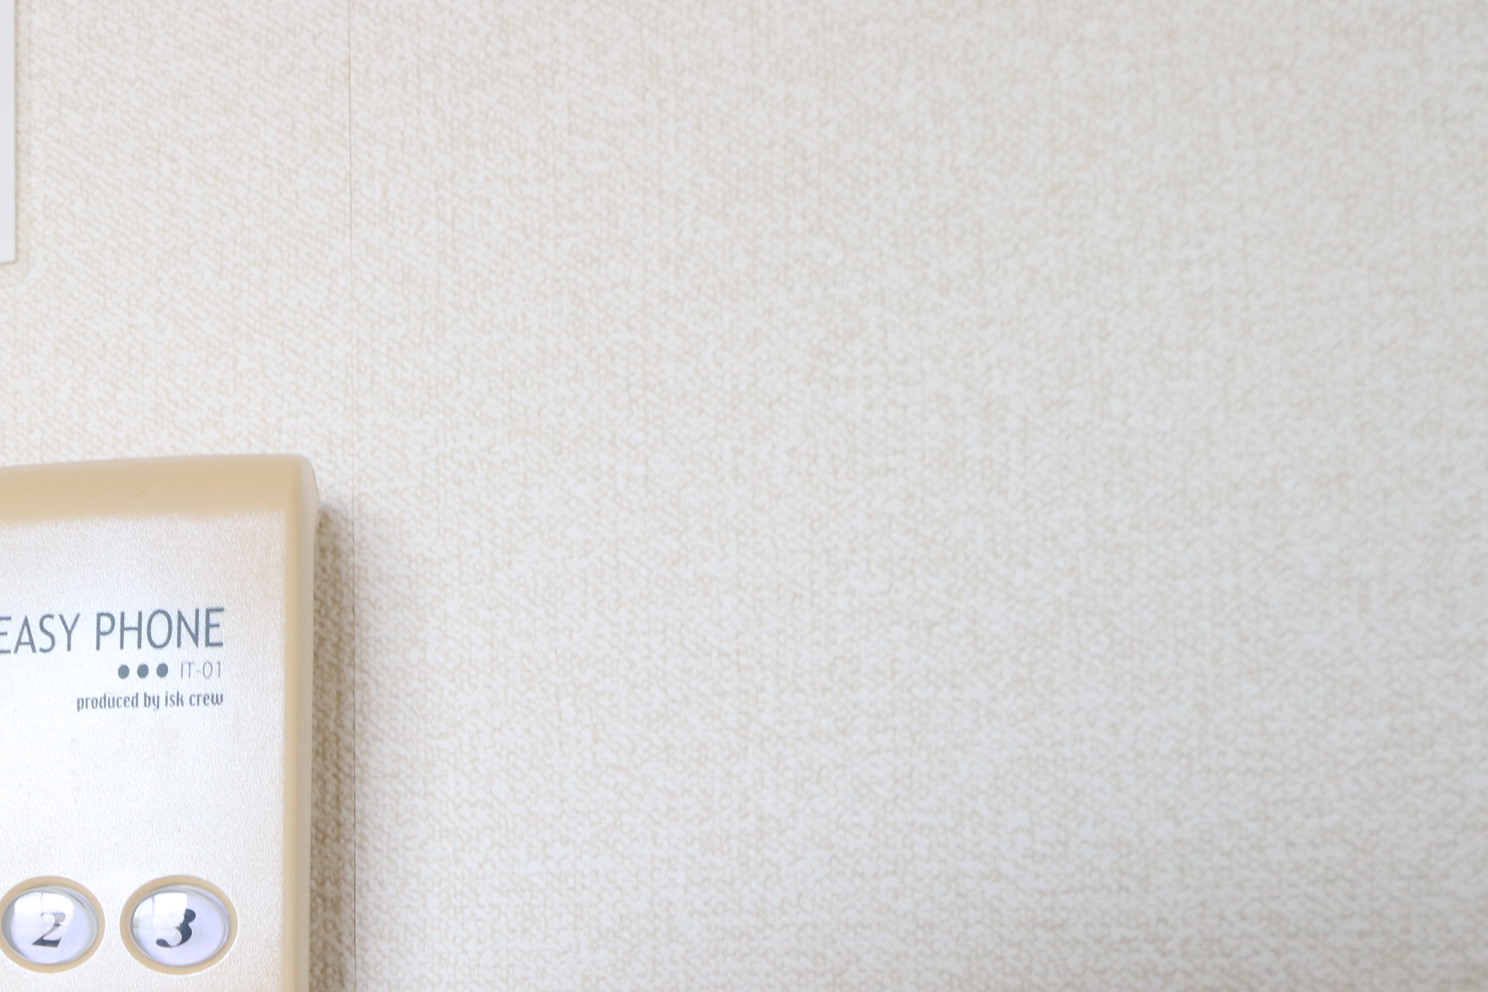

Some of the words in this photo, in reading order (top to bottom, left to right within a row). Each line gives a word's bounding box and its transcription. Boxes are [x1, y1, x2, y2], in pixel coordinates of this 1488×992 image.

[95, 606, 225, 652] PHONE
[180, 660, 222, 680] IT-01
[76, 692, 140, 713] produced
[143, 691, 161, 710] by
[164, 690, 185, 708] isk
[188, 692, 224, 707] crew
[31, 911, 65, 948] 2
[155, 908, 197, 948] 3
